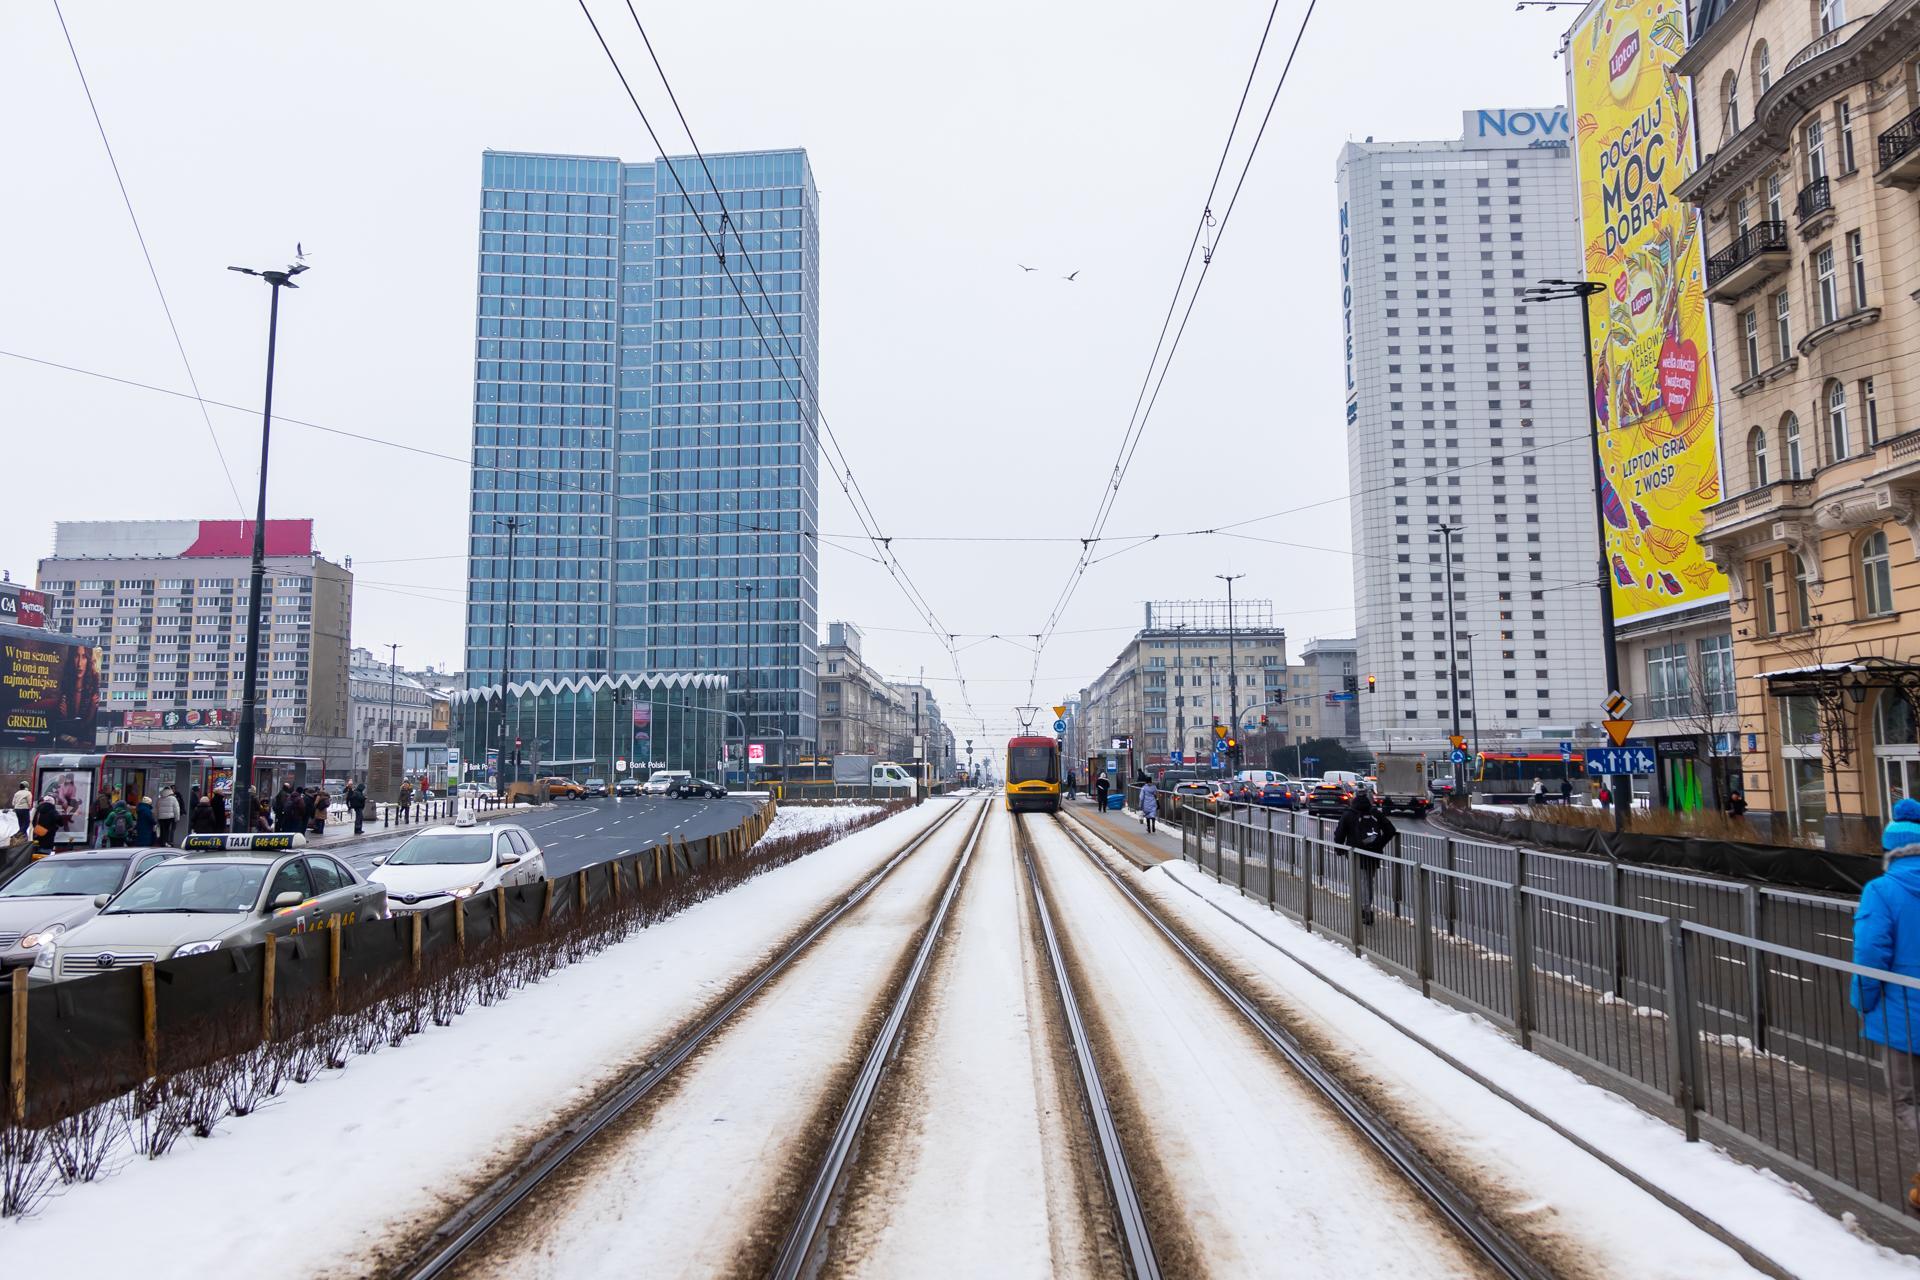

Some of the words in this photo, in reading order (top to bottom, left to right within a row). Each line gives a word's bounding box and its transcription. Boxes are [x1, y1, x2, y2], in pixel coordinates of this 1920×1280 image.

[1610, 37, 1637, 75] Lipton
[1600, 97, 1662, 178] POCZUJ
[1602, 133, 1665, 224] MOC
[1605, 183, 1668, 256] DOBRA
[1340, 201, 1354, 390] NOVOTEL
[1632, 292, 1651, 312] Lipton
[1631, 333, 1659, 357] YELLOW
[1635, 352, 1657, 372] LABEL
[1622, 447, 1659, 478] LIPTON
[1662, 436, 1685, 459] GRA
[1635, 480, 1641, 496] Z
[1643, 464, 1674, 492] WOŚP
[1, 597, 17, 613] C&A
[5, 645, 15, 657] W
[16, 648, 31, 662] tym
[32, 651, 60, 663] sezonie
[13, 661, 21, 671] to
[22, 663, 36, 673] ona
[37, 665, 49, 675] ma
[3, 673, 58, 690] najmodniejsze
[19, 688, 42, 702] torby.
[7, 715, 48, 729] GRISELDA
[629, 761, 646, 769] Bank
[647, 761, 666, 769] Polski
[229, 837, 250, 847] TAXI
